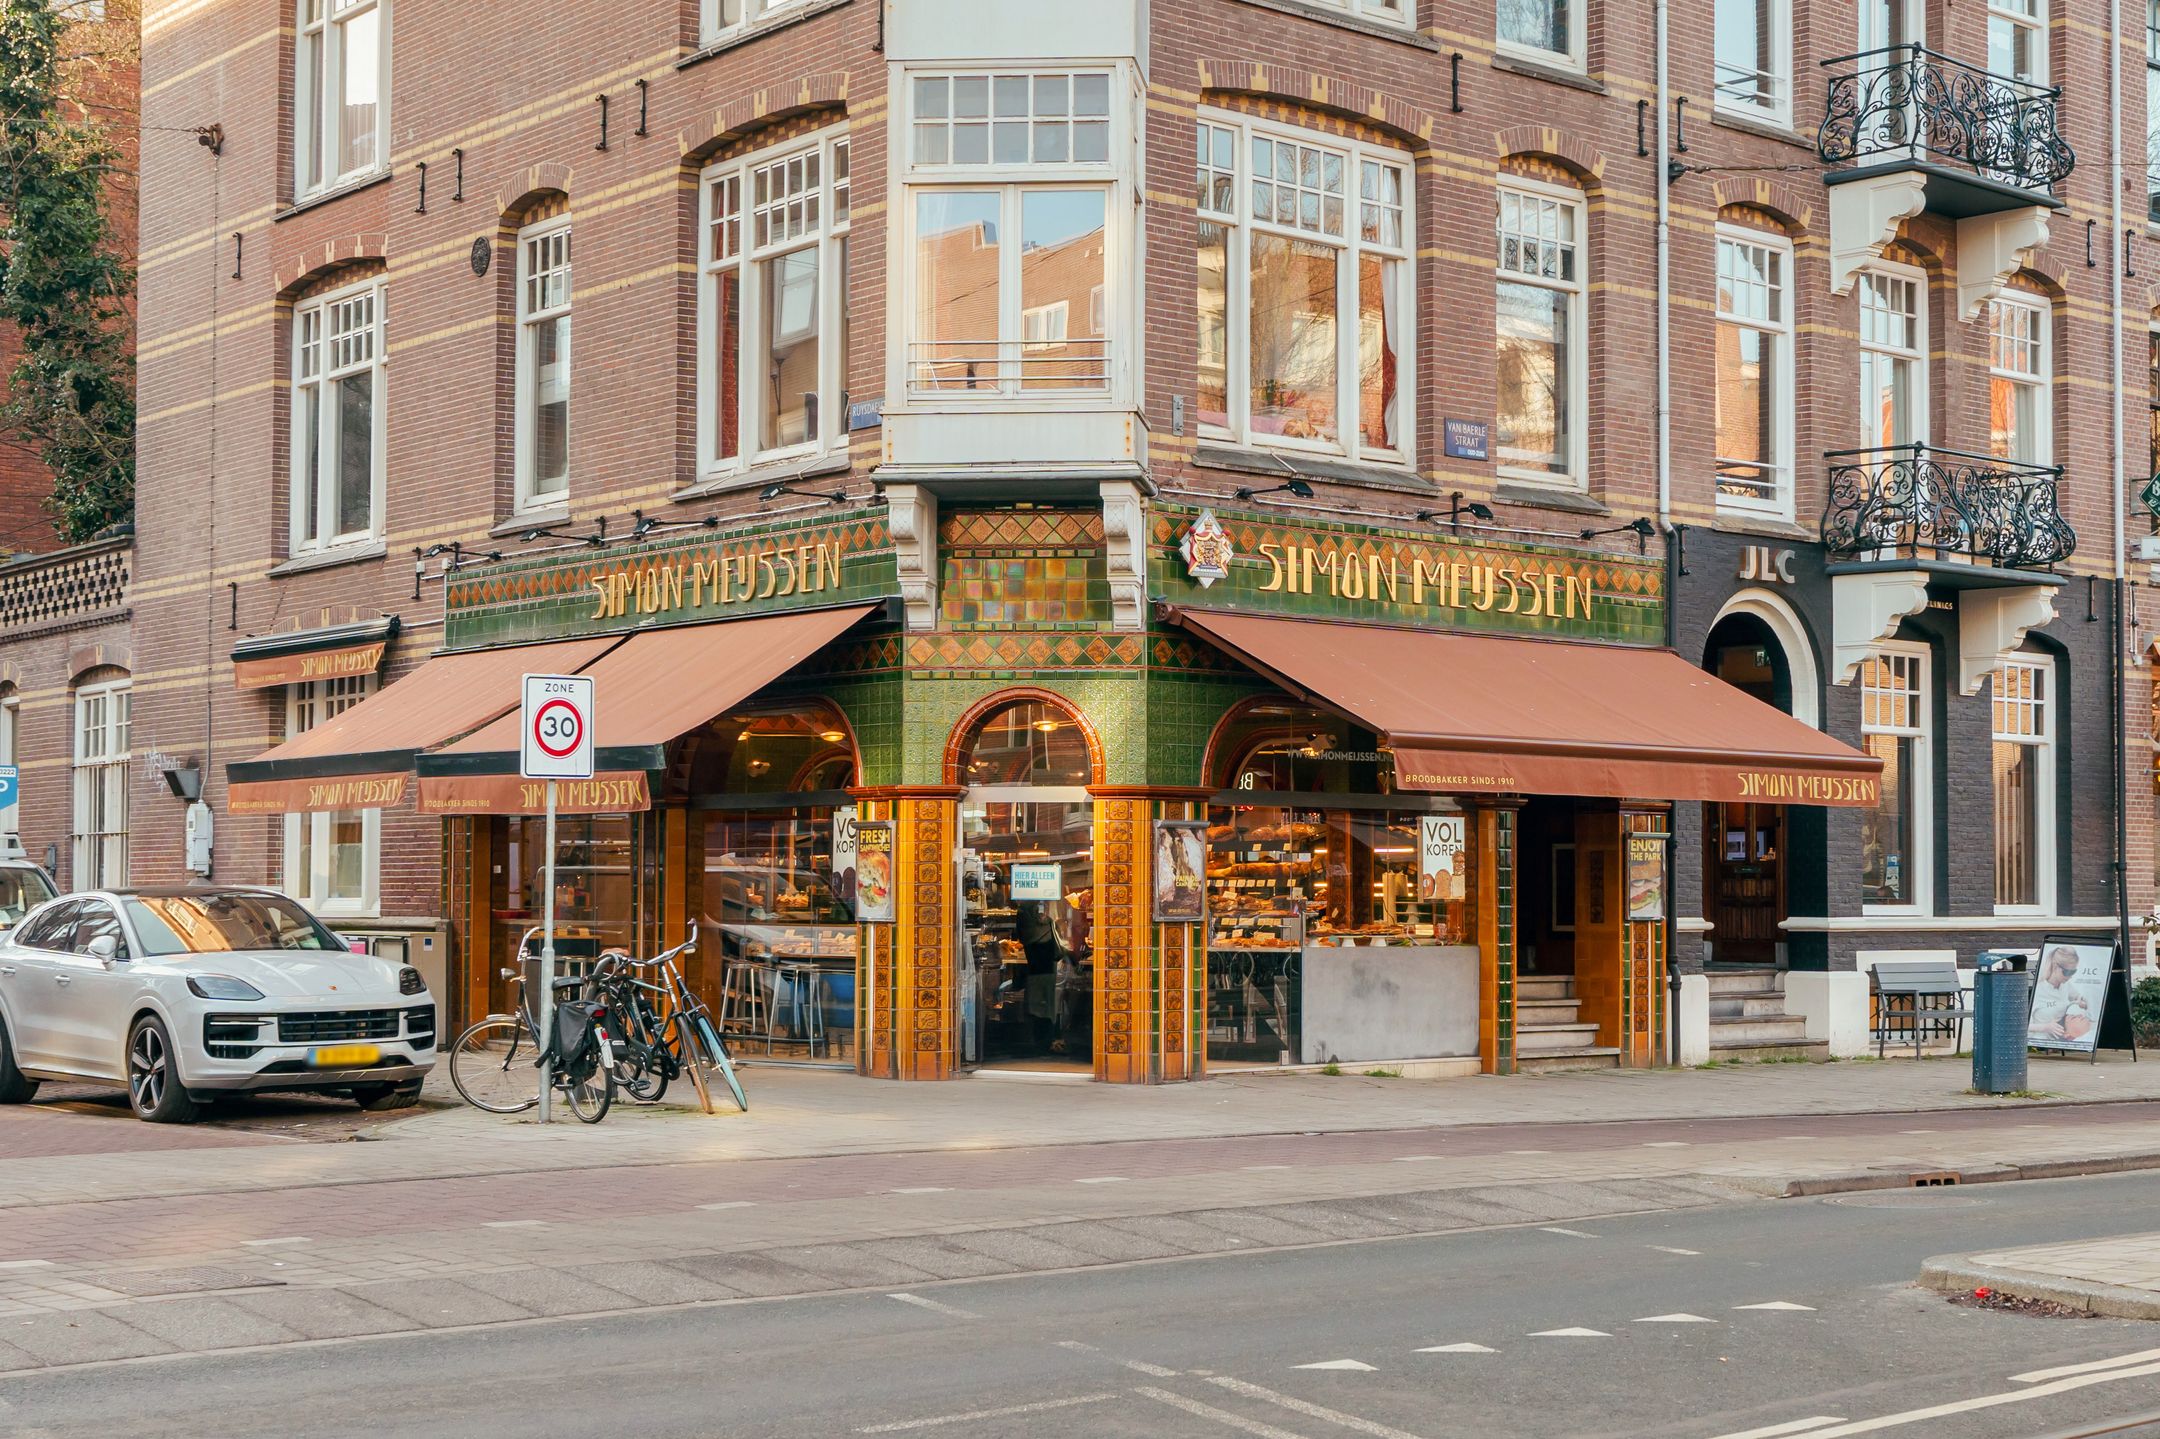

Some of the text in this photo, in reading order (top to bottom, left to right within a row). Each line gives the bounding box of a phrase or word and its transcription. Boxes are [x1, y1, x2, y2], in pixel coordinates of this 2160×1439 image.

[1447, 422, 1486, 437] VAN BAERLE
[1455, 435, 1479, 448] STRAAT
[1739, 545, 1796, 584] JLC
[1258, 543, 1397, 602] SIMON
[591, 565, 682, 619] SIMON
[301, 655, 332, 677] SIMON
[545, 683, 574, 693] ZONE
[543, 716, 575, 738] 30
[1405, 774, 1515, 786] BROODBAKKER SINDS 1910
[1737, 772, 1794, 797] SIMON
[307, 784, 345, 807] SIMON
[520, 783, 565, 808] SIMN
[836, 817, 857, 839] VO
[1425, 822, 1462, 843] VOL
[860, 829, 891, 843] FRESH
[836, 840, 855, 853] KOR
[1426, 844, 1462, 856] KOREN
[1630, 839, 1662, 852] ENJOY
[1630, 852, 1662, 861] THE PARK
[1014, 871, 1056, 880] HIER ALLEEN
[1014, 880, 1039, 889] PINNEN
[2082, 967, 2098, 976] JLC
